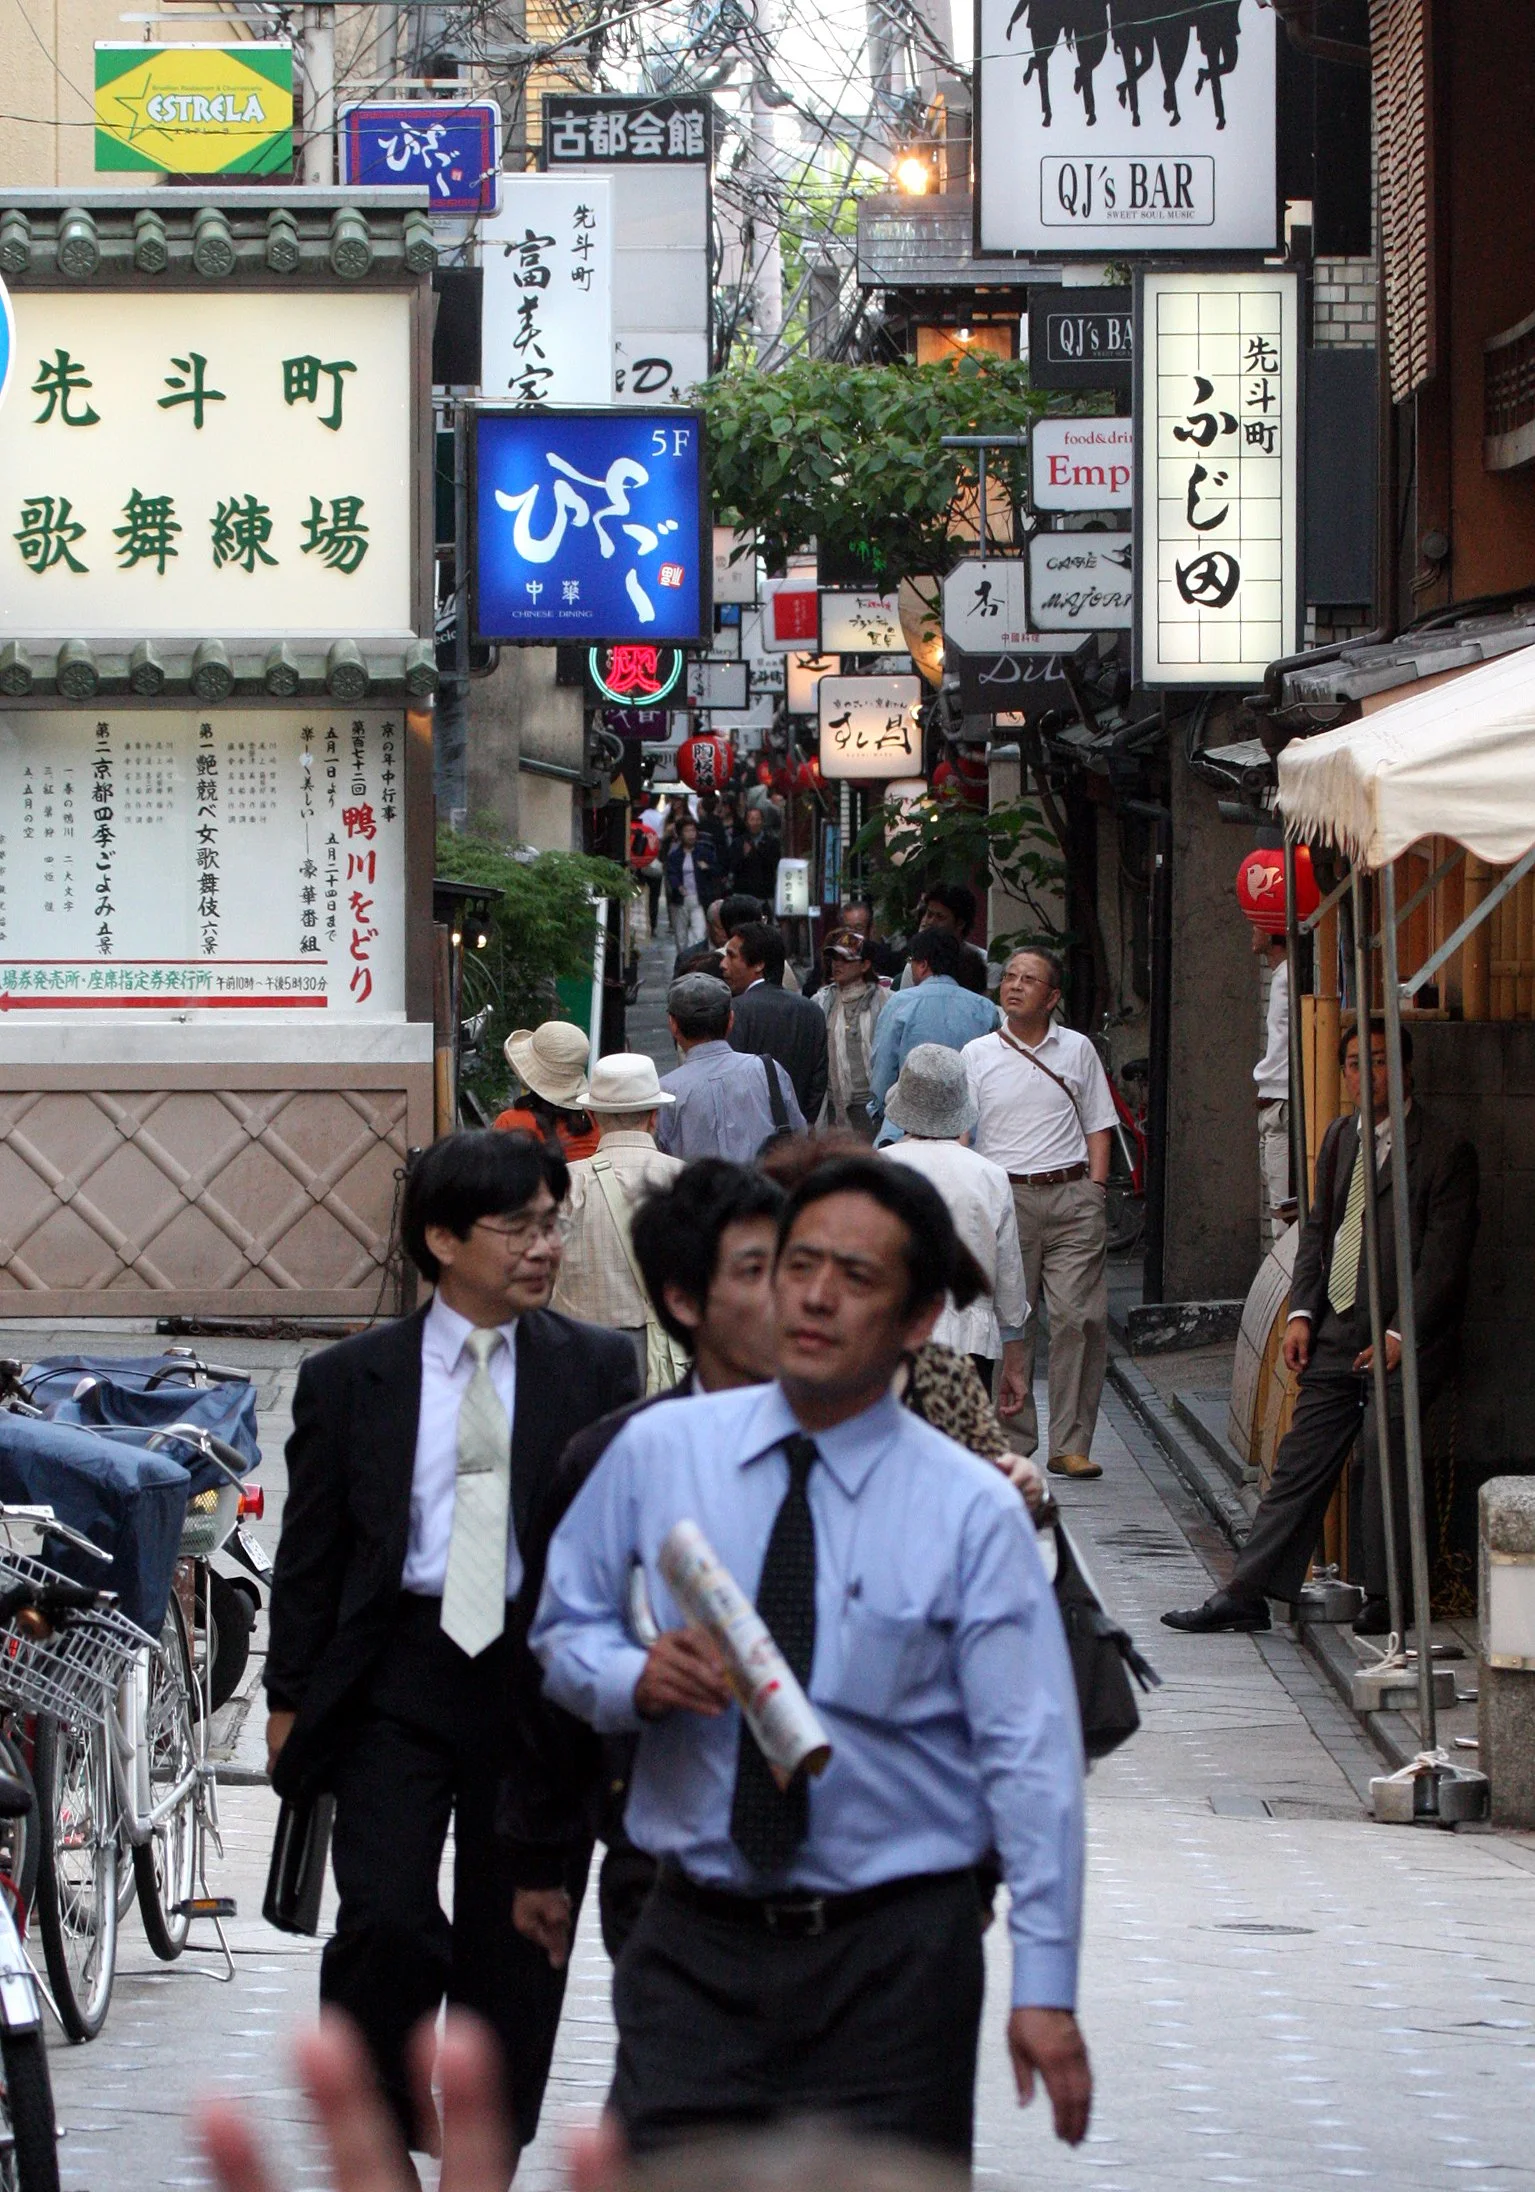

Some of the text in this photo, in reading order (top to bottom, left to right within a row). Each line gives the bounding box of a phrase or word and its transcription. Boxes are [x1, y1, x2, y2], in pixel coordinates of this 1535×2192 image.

[146, 93, 266, 124] ESTRELA
[551, 109, 705, 157] 古都会館
[1106, 211, 1195, 220] SWEET SOUL MUSIC
[1129, 162, 1195, 209] BAR
[570, 203, 597, 292] 先斗町
[503, 228, 556, 408] 富美家
[1107, 318, 1133, 350] BA
[31, 347, 358, 432] 先斗町
[1242, 335, 1279, 455] 先斗町
[651, 430, 690, 457] 5F
[1046, 454, 1133, 493] Emp
[12, 486, 370, 576] 歌舞練場
[1173, 375, 1241, 609] ふじ田
[512, 609, 593, 618] CHINESE DINING
[525, 579, 581, 605] 中華
[351, 719, 367, 797] 第百七十二回
[380, 720, 397, 823] 京の年中行事
[323, 726, 340, 942] 五月一日より 五月二十四日まで
[299, 857, 321, 954] 豪華番組
[341, 801, 380, 1004] 鴨川をどり
